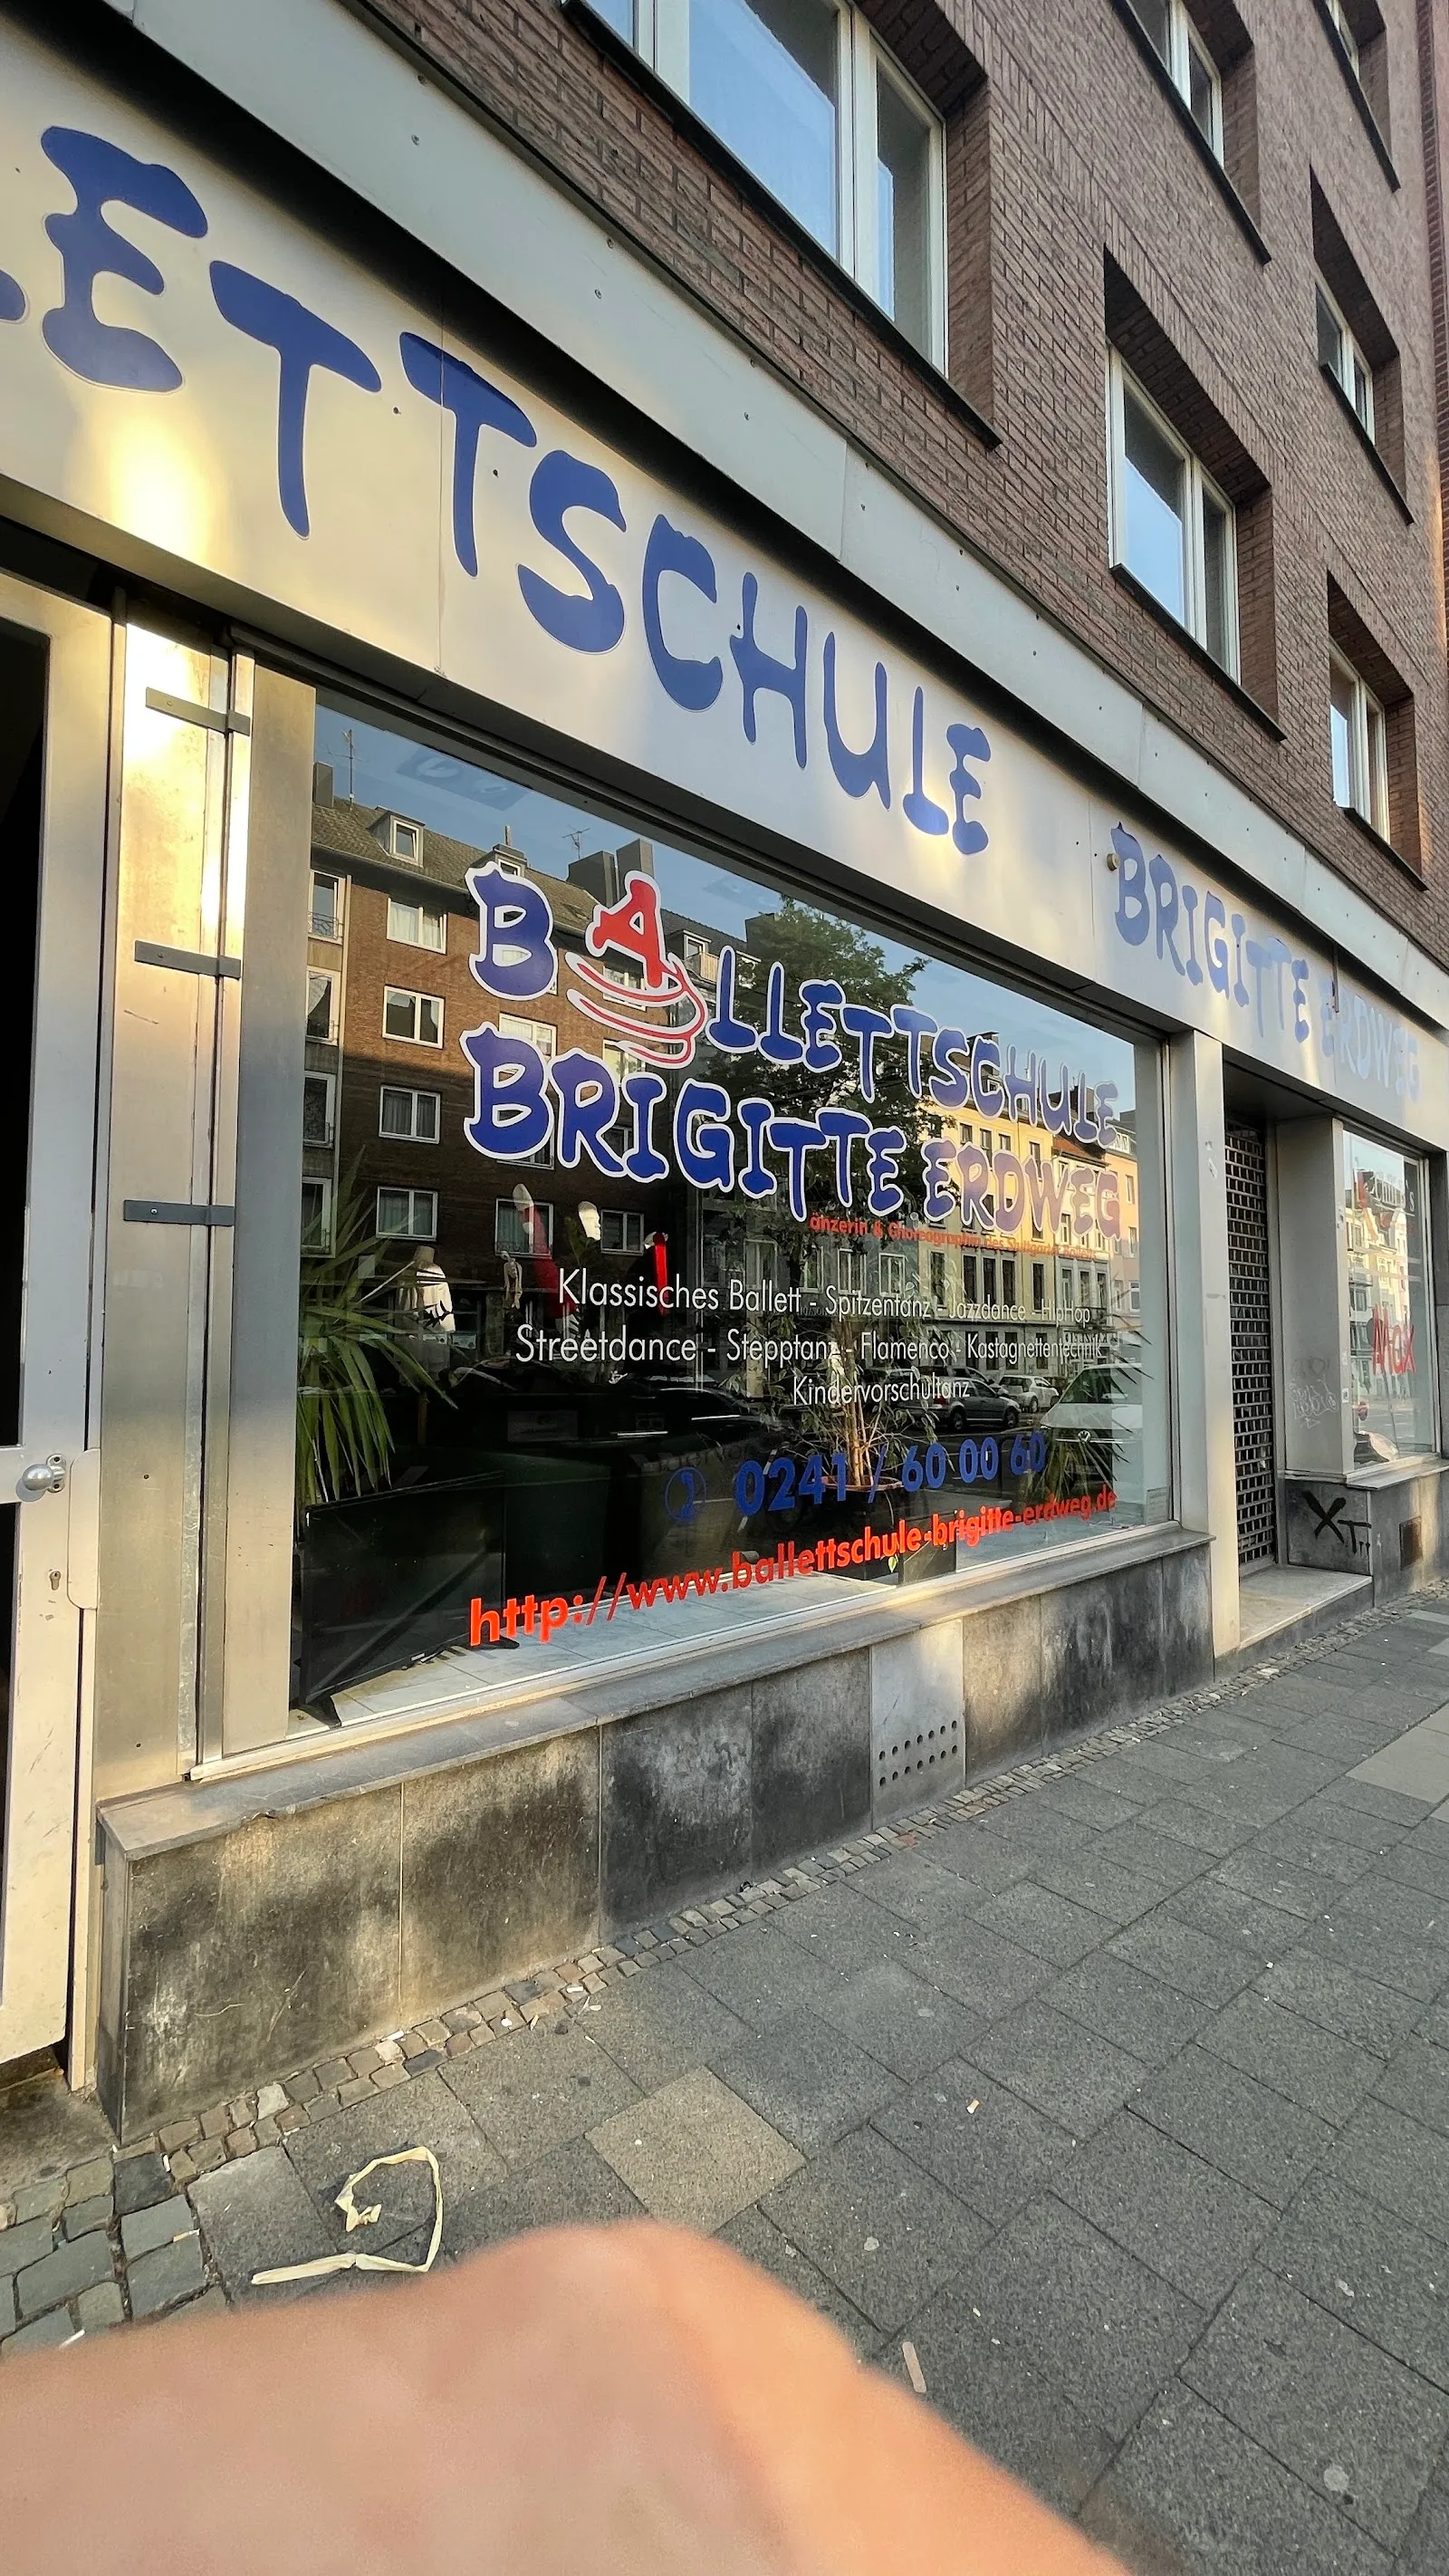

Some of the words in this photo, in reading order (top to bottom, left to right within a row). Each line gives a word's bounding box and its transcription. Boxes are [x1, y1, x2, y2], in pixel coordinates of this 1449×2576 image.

[0, 126, 991, 855] ETTSCHULE
[1110, 822, 1310, 1043] BRIGITTE
[465, 861, 1119, 1149] BALLETTSCHULE
[460, 1022, 905, 1222] BRIGITTE
[921, 1138, 1121, 1240] ERDWEG
[515, 1324, 696, 1361] Streetdance
[726, 1328, 840, 1369] Stepptanz
[861, 1331, 949, 1360] Flamenco
[967, 1332, 1102, 1365] Kastagnettentechnik
[559, 1268, 719, 1310] Klassisches
[729, 1279, 801, 1312] Ballett
[825, 1284, 932, 1322] Spitzentanz
[948, 1293, 1026, 1322] Jazzdance
[1041, 1298, 1090, 1329] HipHop
[793, 1372, 971, 1405] Kindervorschultanz
[734, 1452, 848, 1516] 0241
[901, 1443, 946, 1493] 60
[958, 1437, 1000, 1484] 00
[1010, 1431, 1046, 1475] 60
[469, 1483, 1117, 1647] http://www.ballettschule-brigitte-erdweg.de
